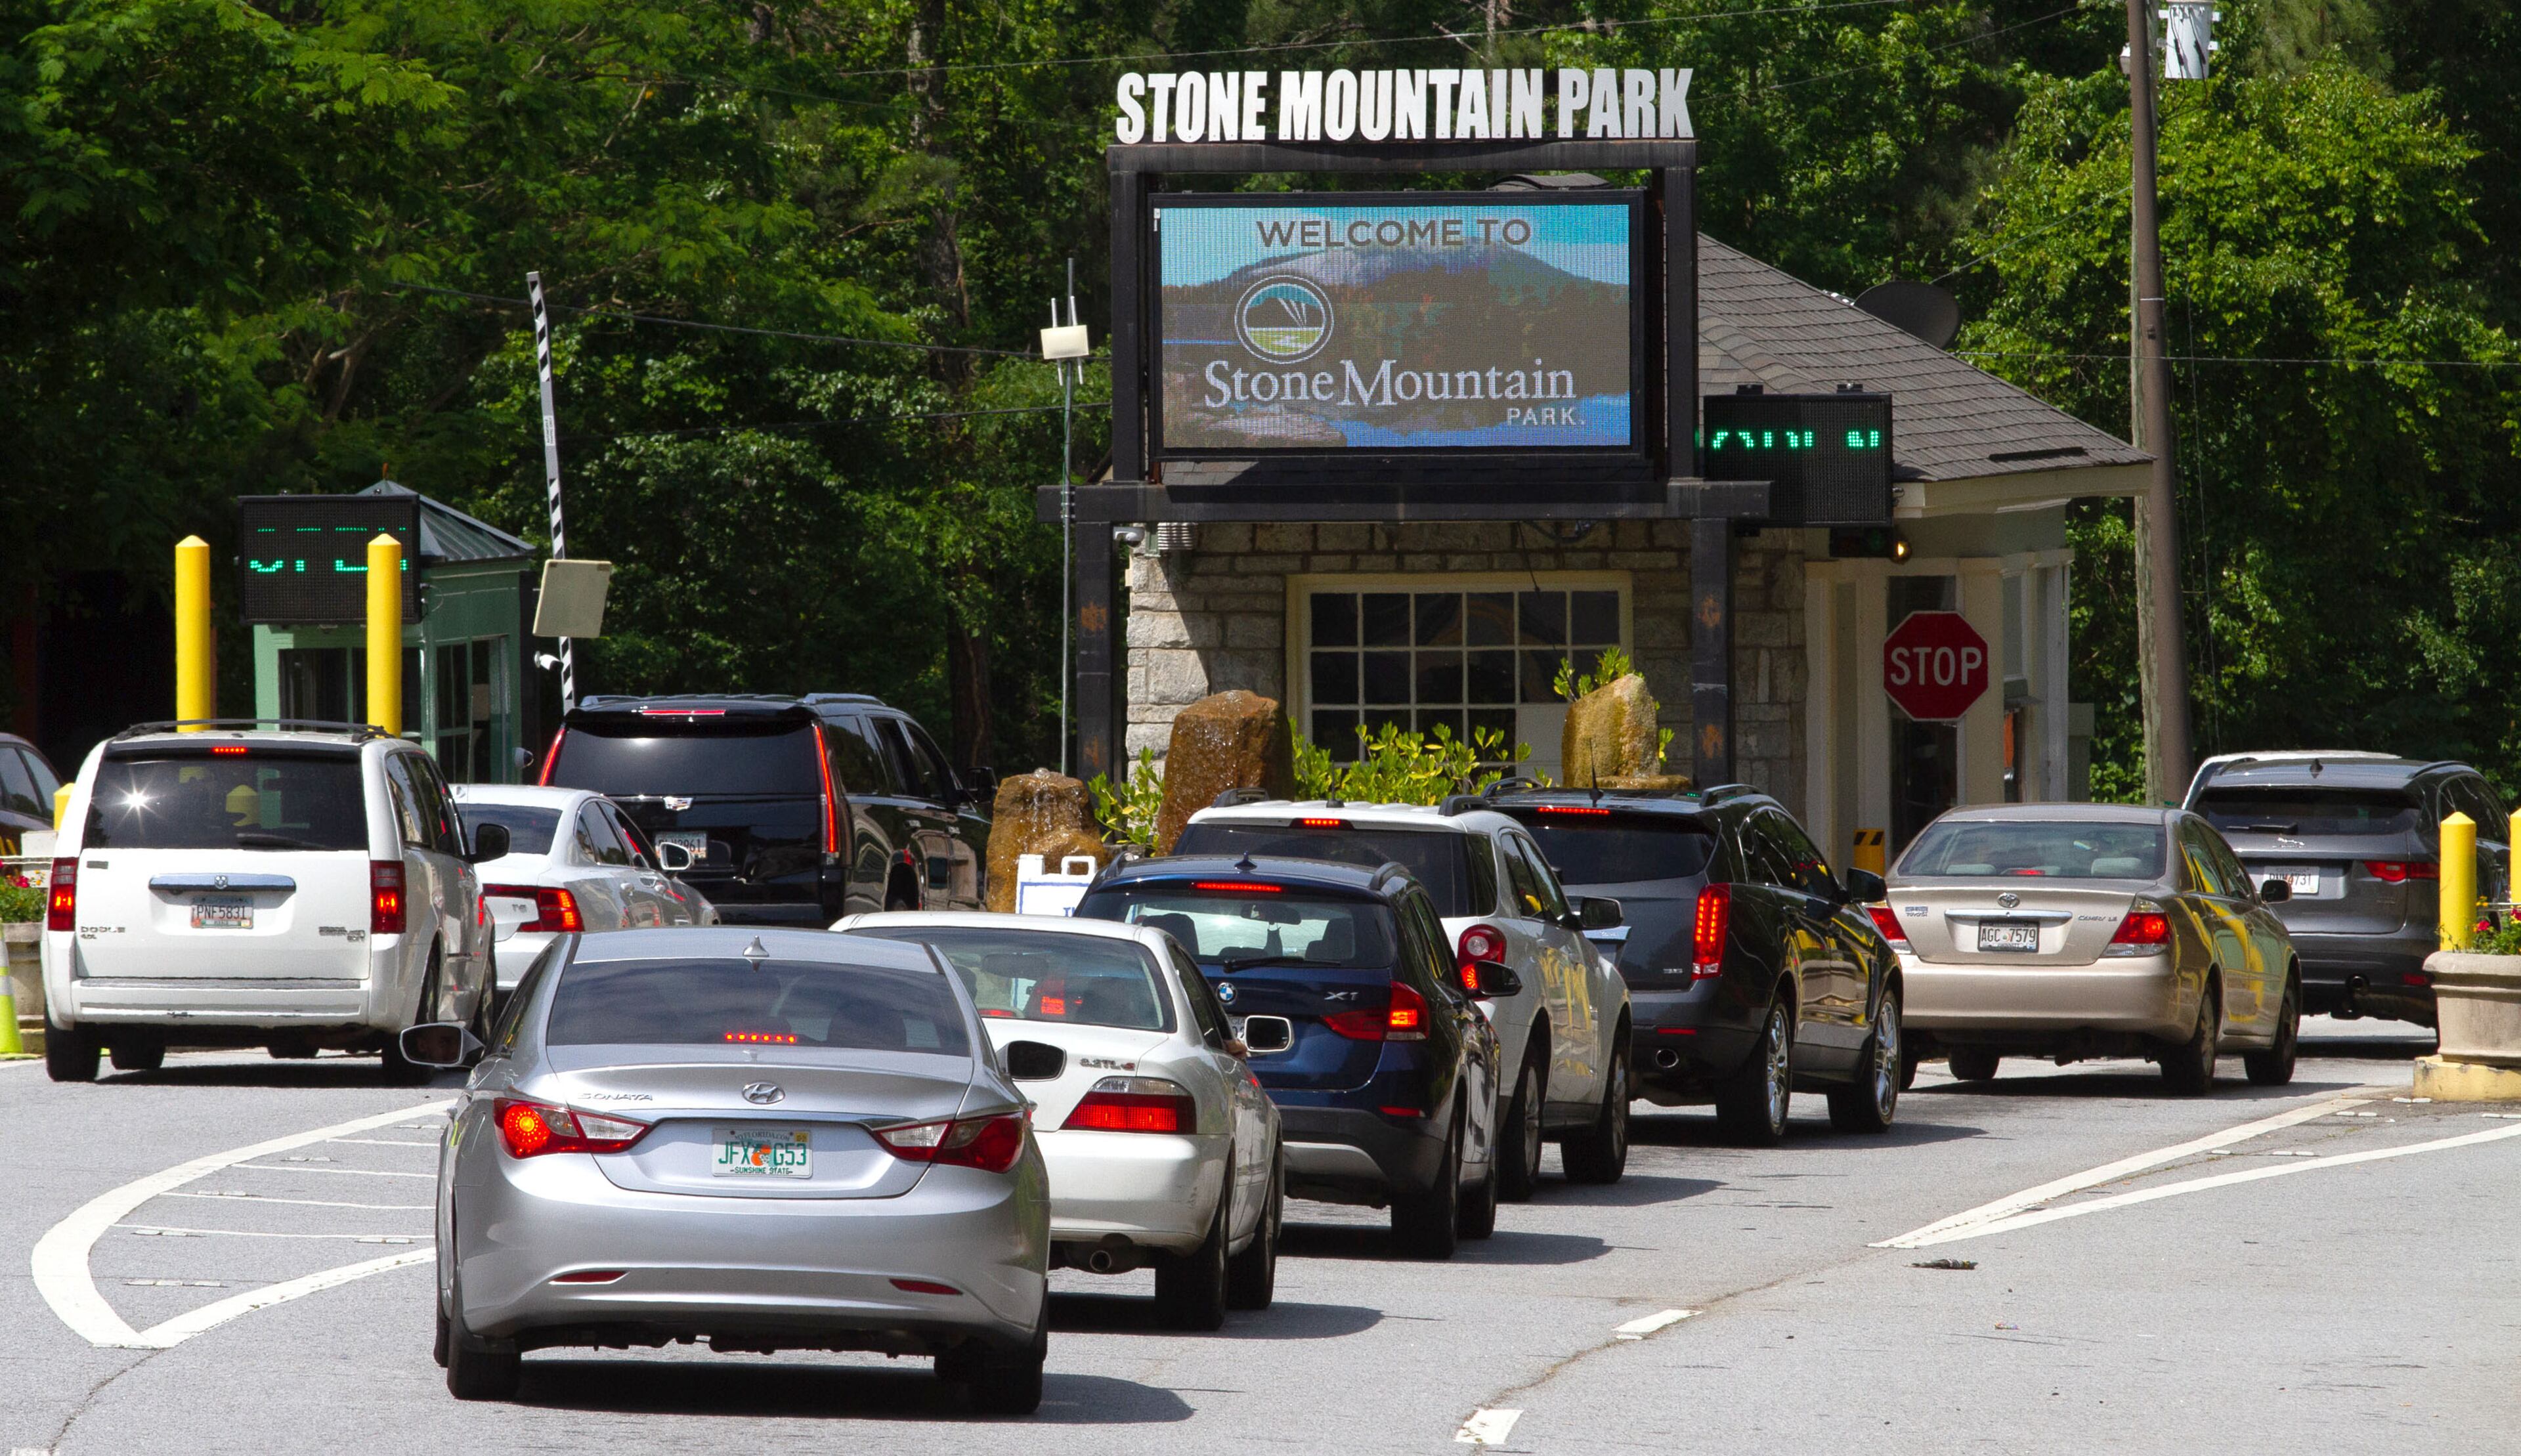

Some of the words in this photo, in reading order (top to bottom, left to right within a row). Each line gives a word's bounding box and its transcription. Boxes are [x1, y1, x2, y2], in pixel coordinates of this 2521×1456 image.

[1116, 71, 1267, 144] STONE
[1278, 68, 1543, 142] MOUNTAIN
[1557, 68, 1694, 139] PARK
[1256, 219, 1463, 247] WELCOME
[1475, 218, 1532, 246] TO
[1890, 646, 1982, 686] STOP
[1981, 928, 2000, 942] AGC
[2009, 928, 2036, 943] 7579
[1324, 991, 1359, 1001] X1
[577, 1092, 653, 1101] SONATA
[735, 1129, 790, 1142] MYFLORIDA.COM
[718, 1140, 751, 1165] JFX
[773, 1142, 807, 1167] G53
[734, 1166, 767, 1174] SUNSHINE
